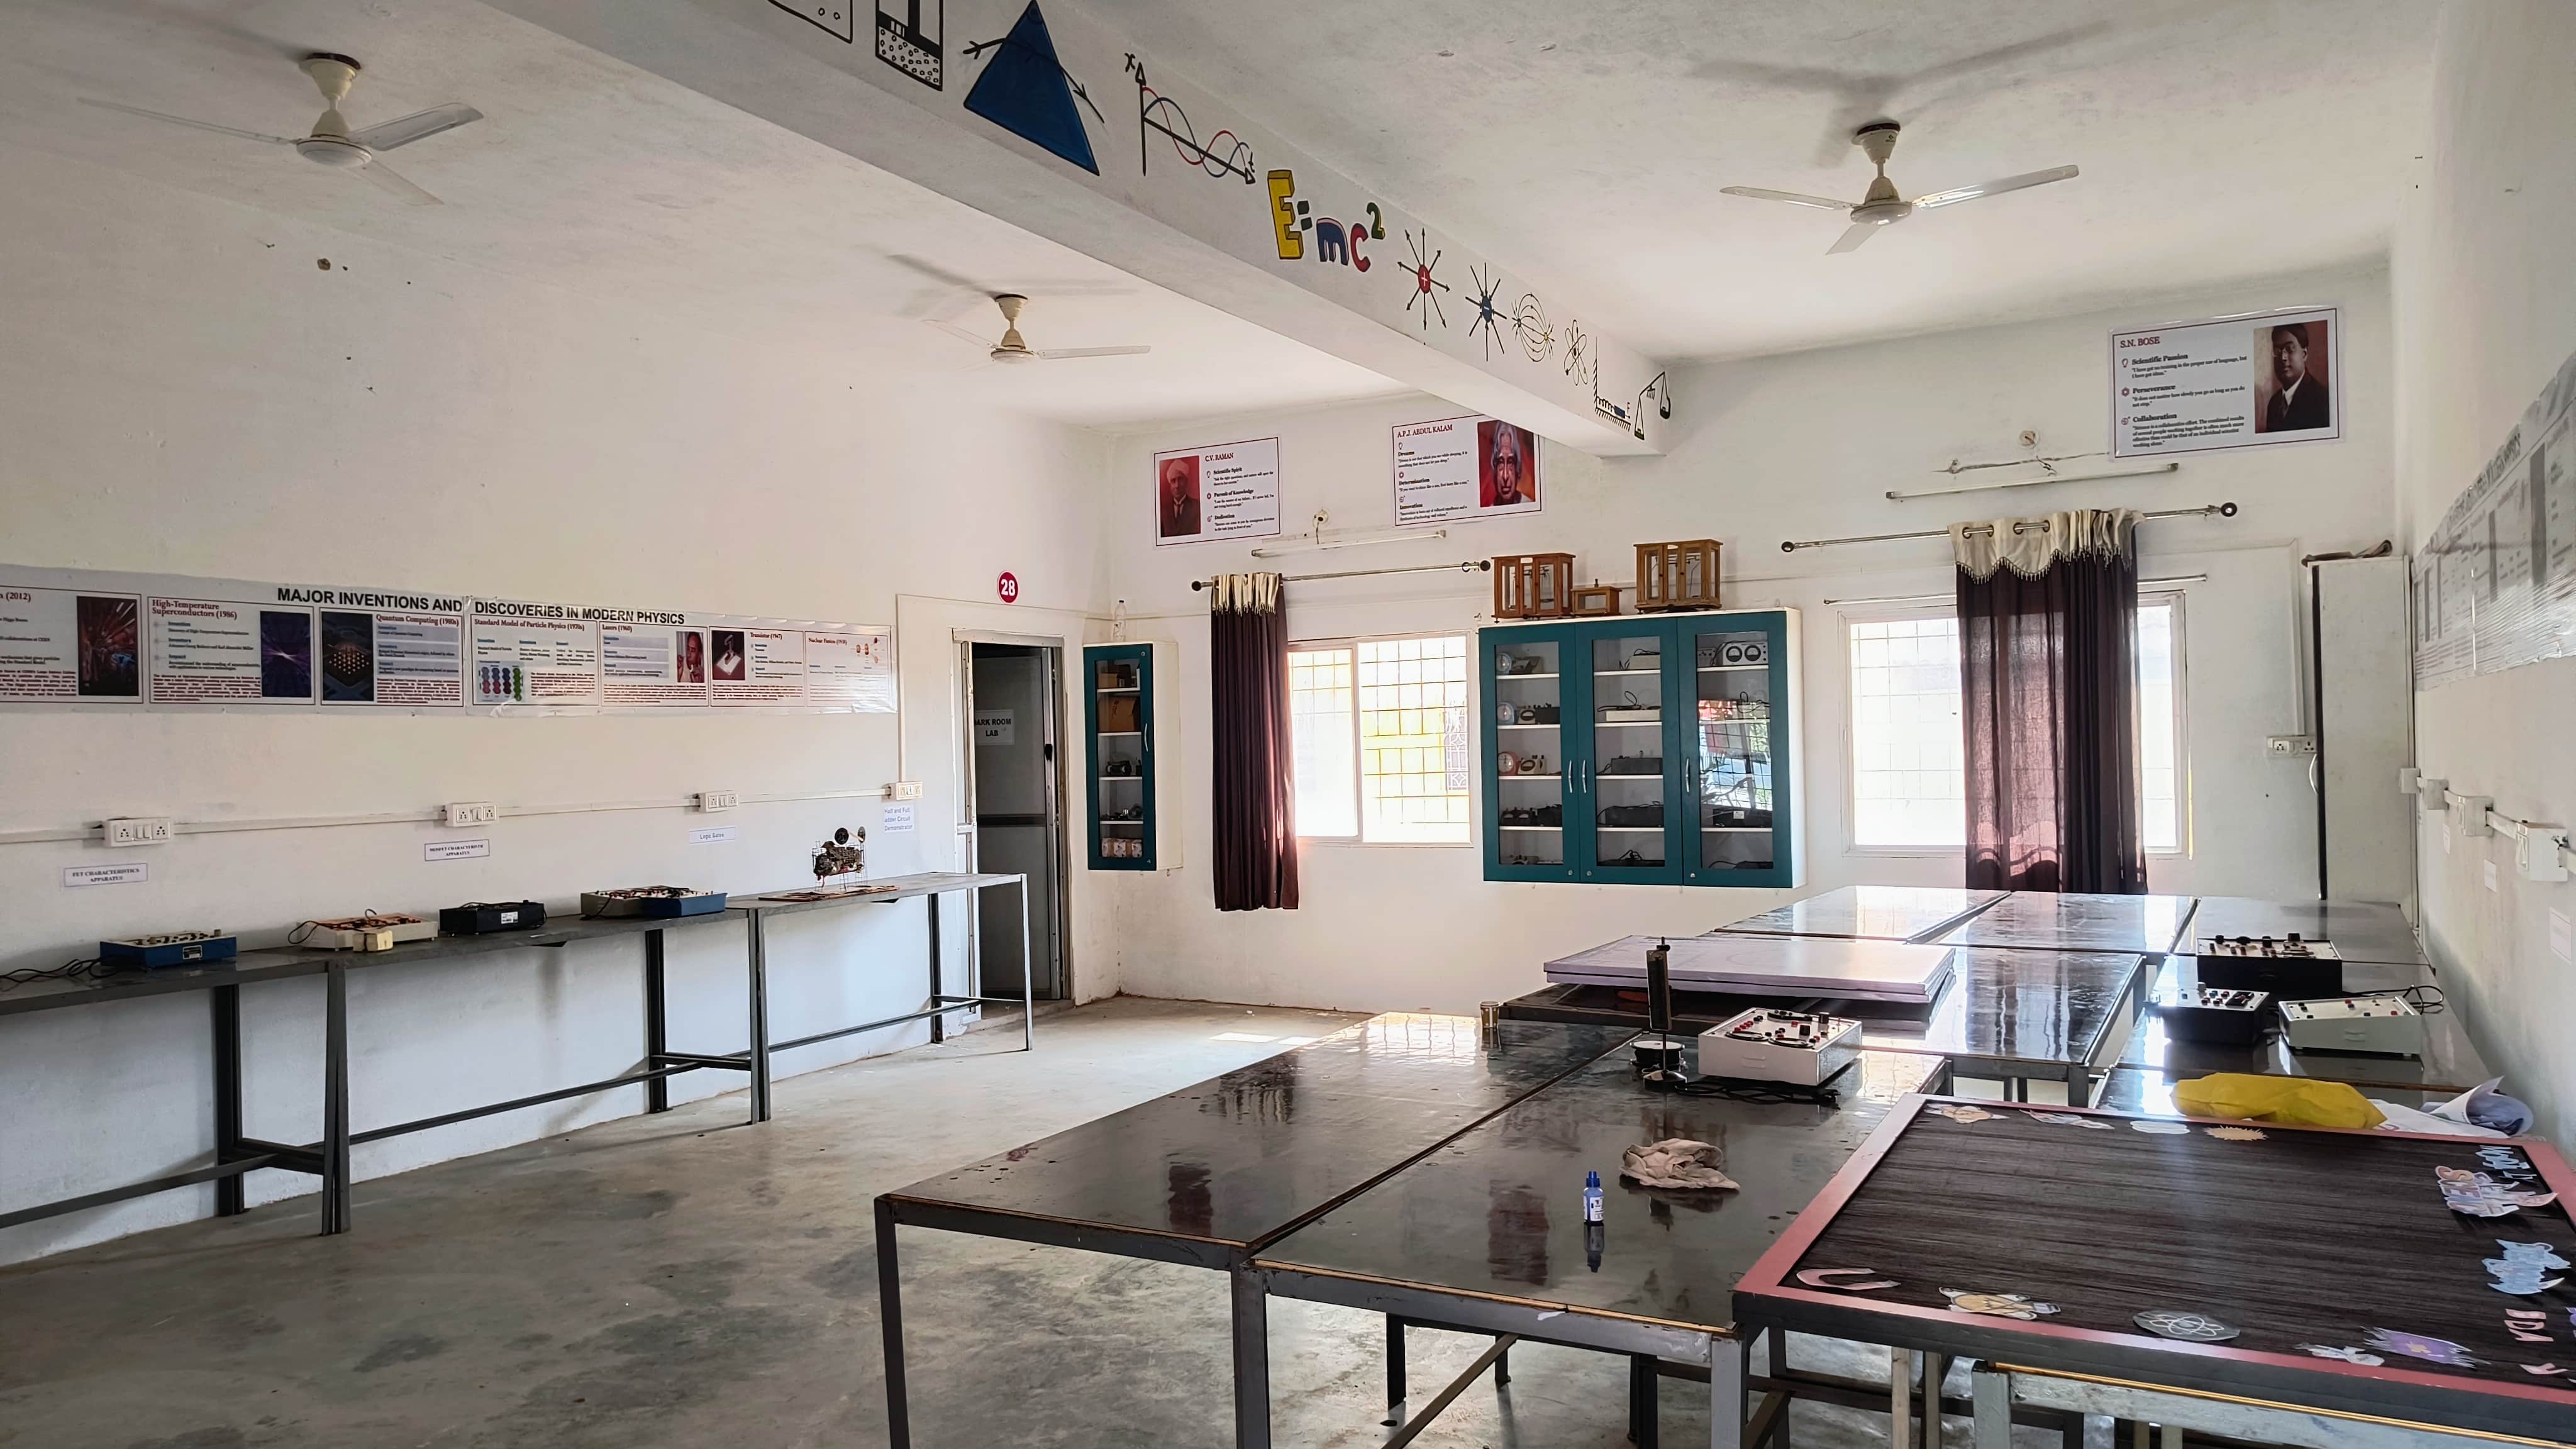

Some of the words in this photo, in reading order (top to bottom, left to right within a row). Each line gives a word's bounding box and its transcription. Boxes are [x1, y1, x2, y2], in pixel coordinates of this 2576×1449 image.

[2120, 340, 2136, 348] S.N.
[2138, 336, 2160, 346] BOSE
[2132, 356, 2162, 365] Scientific
[2133, 385, 2176, 394] Perseverance
[2133, 413, 2177, 423] Collaboration
[1413, 427, 1432, 436] ABDUL
[1433, 424, 1453, 433] KALAM
[1216, 452, 1234, 460] RAMAN
[1001, 579, 1016, 596] 28
[6, 592, 31, 603] (2012)
[152, 599, 219, 610] High-Temperature
[277, 588, 335, 604] MAJOR
[340, 592, 429, 609] INVENTIONS
[433, 599, 462, 612] AND
[475, 601, 563, 618] DISCOVERIES
[567, 606, 579, 618] IN
[582, 608, 633, 622] MODERN
[637, 611, 685, 625] PHYSICS
[152, 608, 214, 617] Superconductors
[216, 611, 237, 621] (1986)
[376, 614, 404, 622] Quantum
[406, 615, 439, 626] Computing
[548, 622, 567, 631] Physics
[84, 868, 140, 877] CHARACTERISTICS
